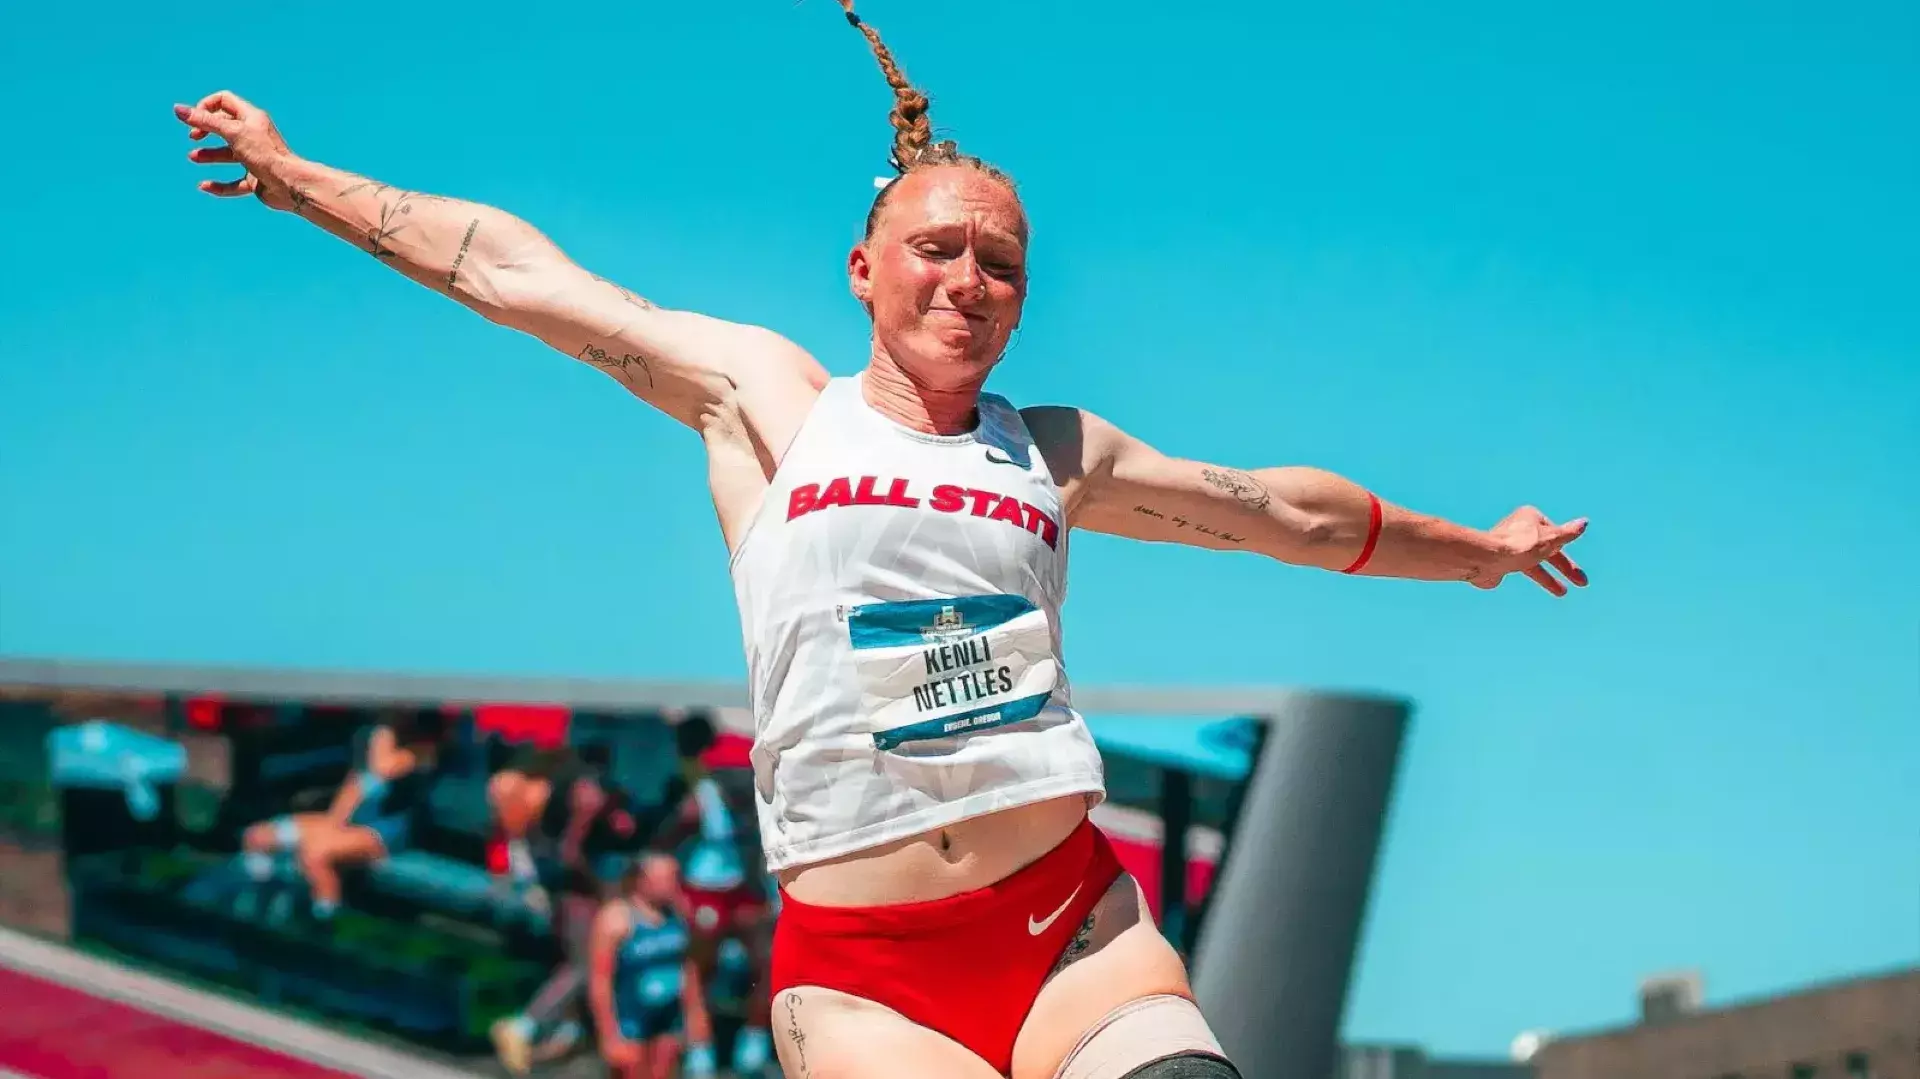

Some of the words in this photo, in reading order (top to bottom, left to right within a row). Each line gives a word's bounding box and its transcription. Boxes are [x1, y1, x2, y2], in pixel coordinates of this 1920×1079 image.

[786, 476, 921, 522] BALL
[923, 636, 992, 675] KENLI
[913, 665, 1013, 713] NETTLES
